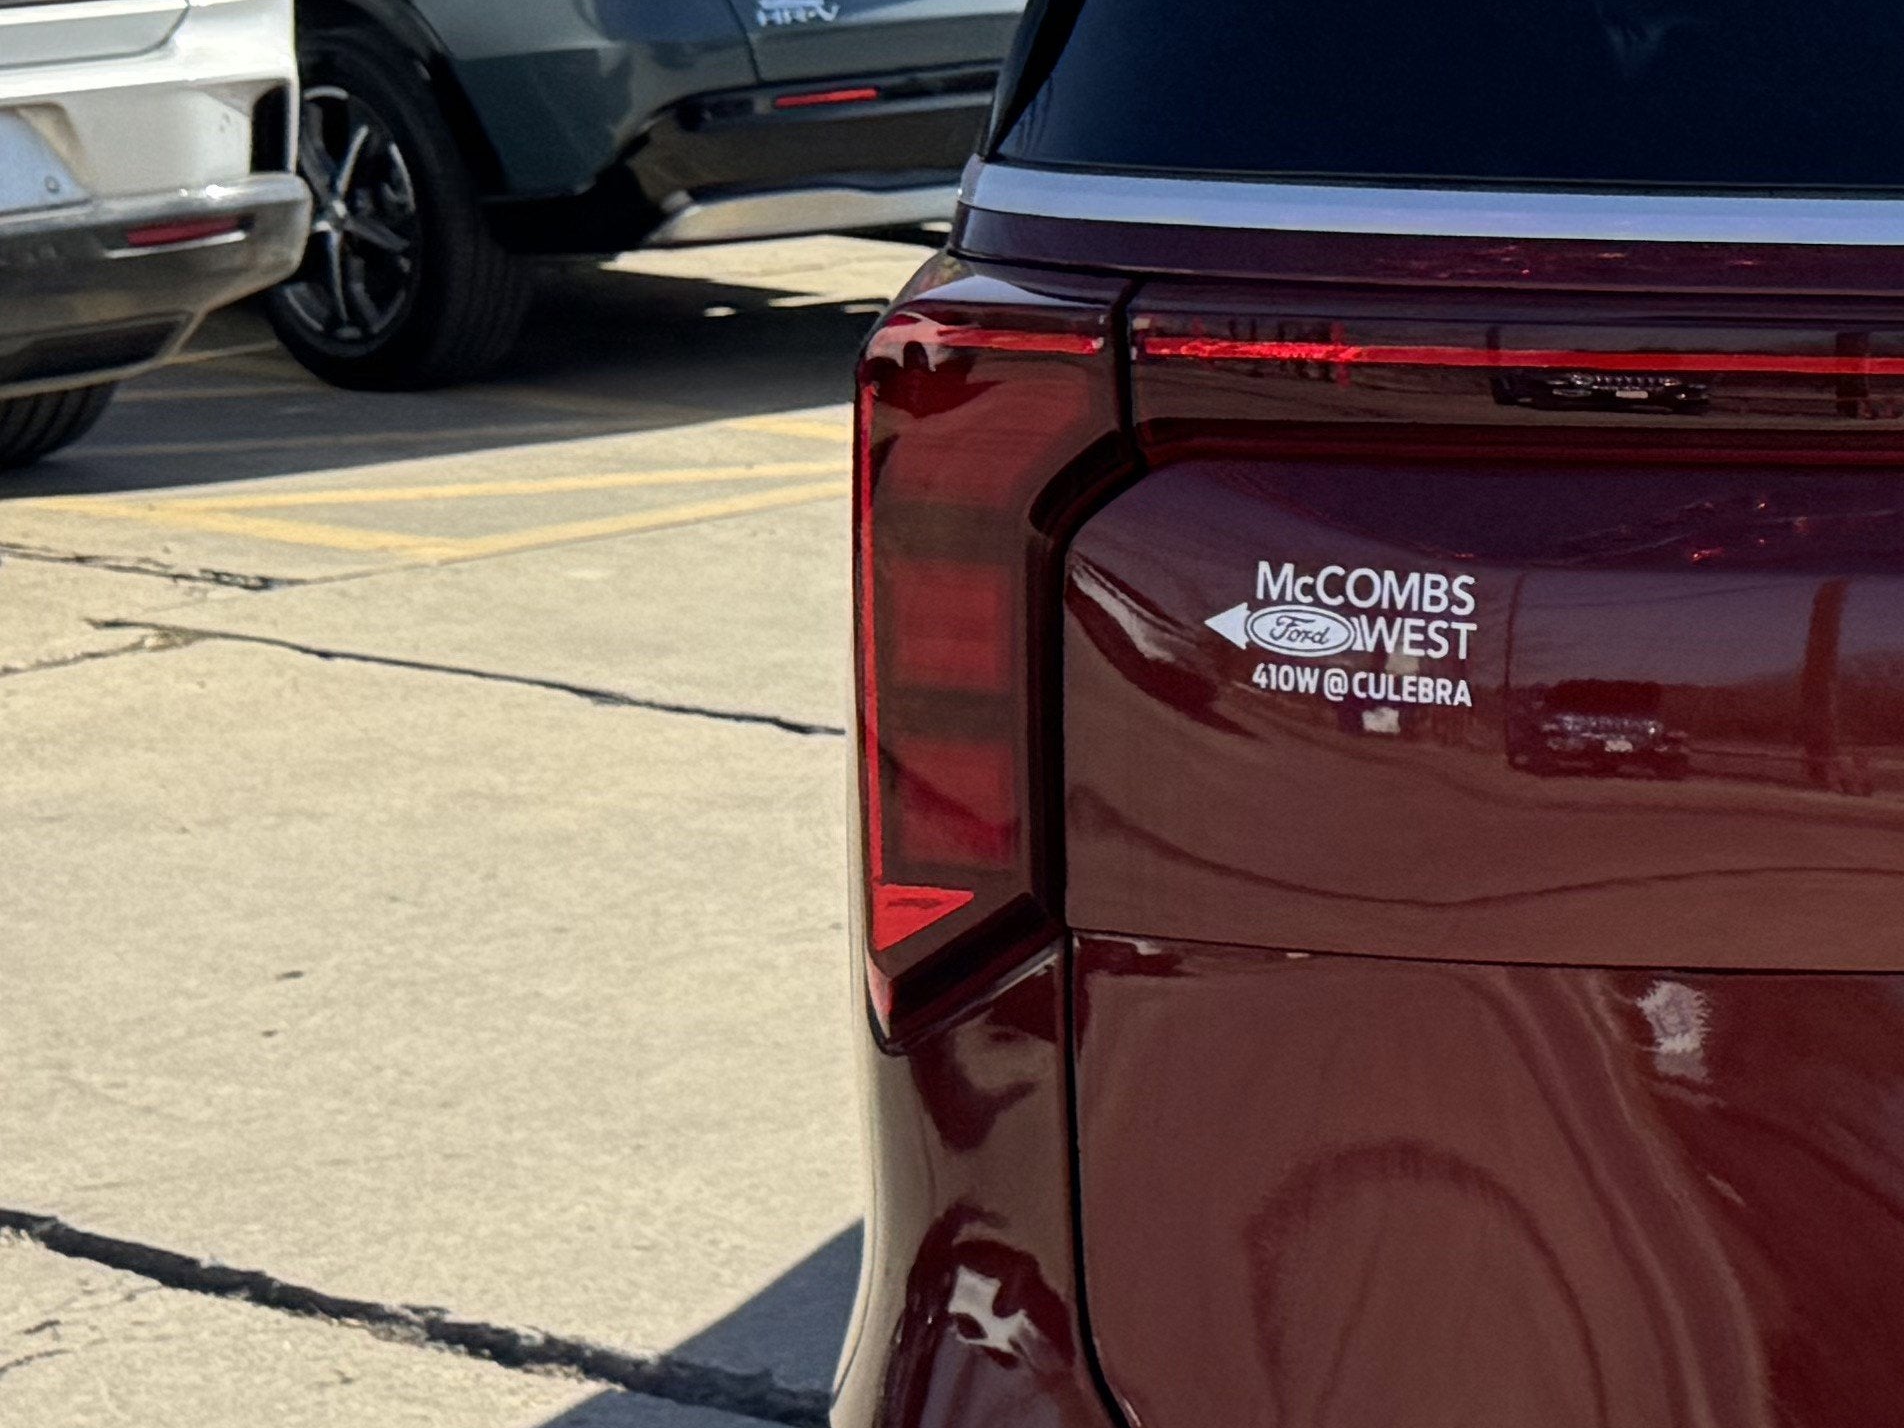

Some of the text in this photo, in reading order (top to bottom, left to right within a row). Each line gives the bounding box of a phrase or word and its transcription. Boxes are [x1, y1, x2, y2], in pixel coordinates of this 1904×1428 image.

[1256, 560, 1476, 616] McCOMBS
[1269, 614, 1477, 660] Ford WEST
[1252, 663, 1473, 707] 410W @ CULEBRA
